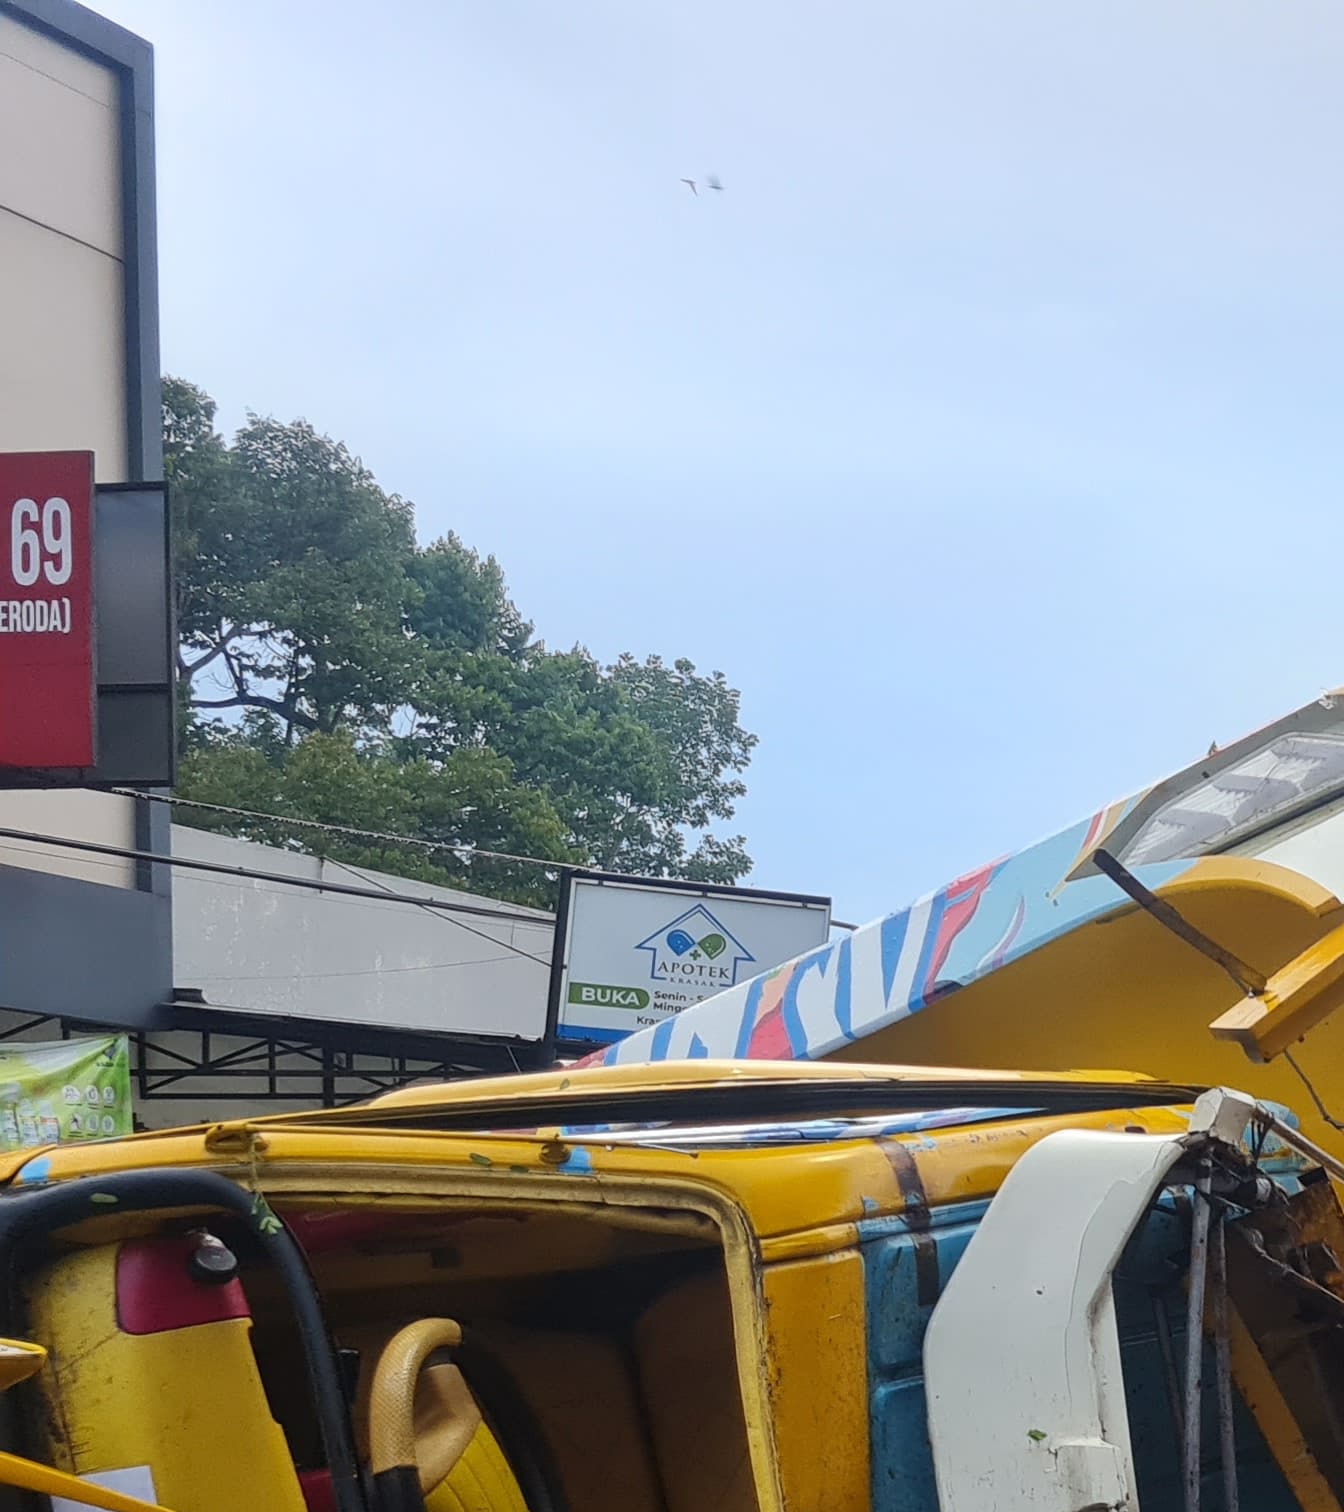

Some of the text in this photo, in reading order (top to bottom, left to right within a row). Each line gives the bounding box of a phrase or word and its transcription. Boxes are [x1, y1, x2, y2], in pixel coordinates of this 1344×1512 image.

[11, 497, 72, 586] 69
[0, 598, 71, 634] ERODA)
[657, 961, 731, 981] APOTEK
[669, 977, 716, 988] KRASAK
[581, 987, 641, 1006] BUKA
[654, 990, 687, 1002] Senin
